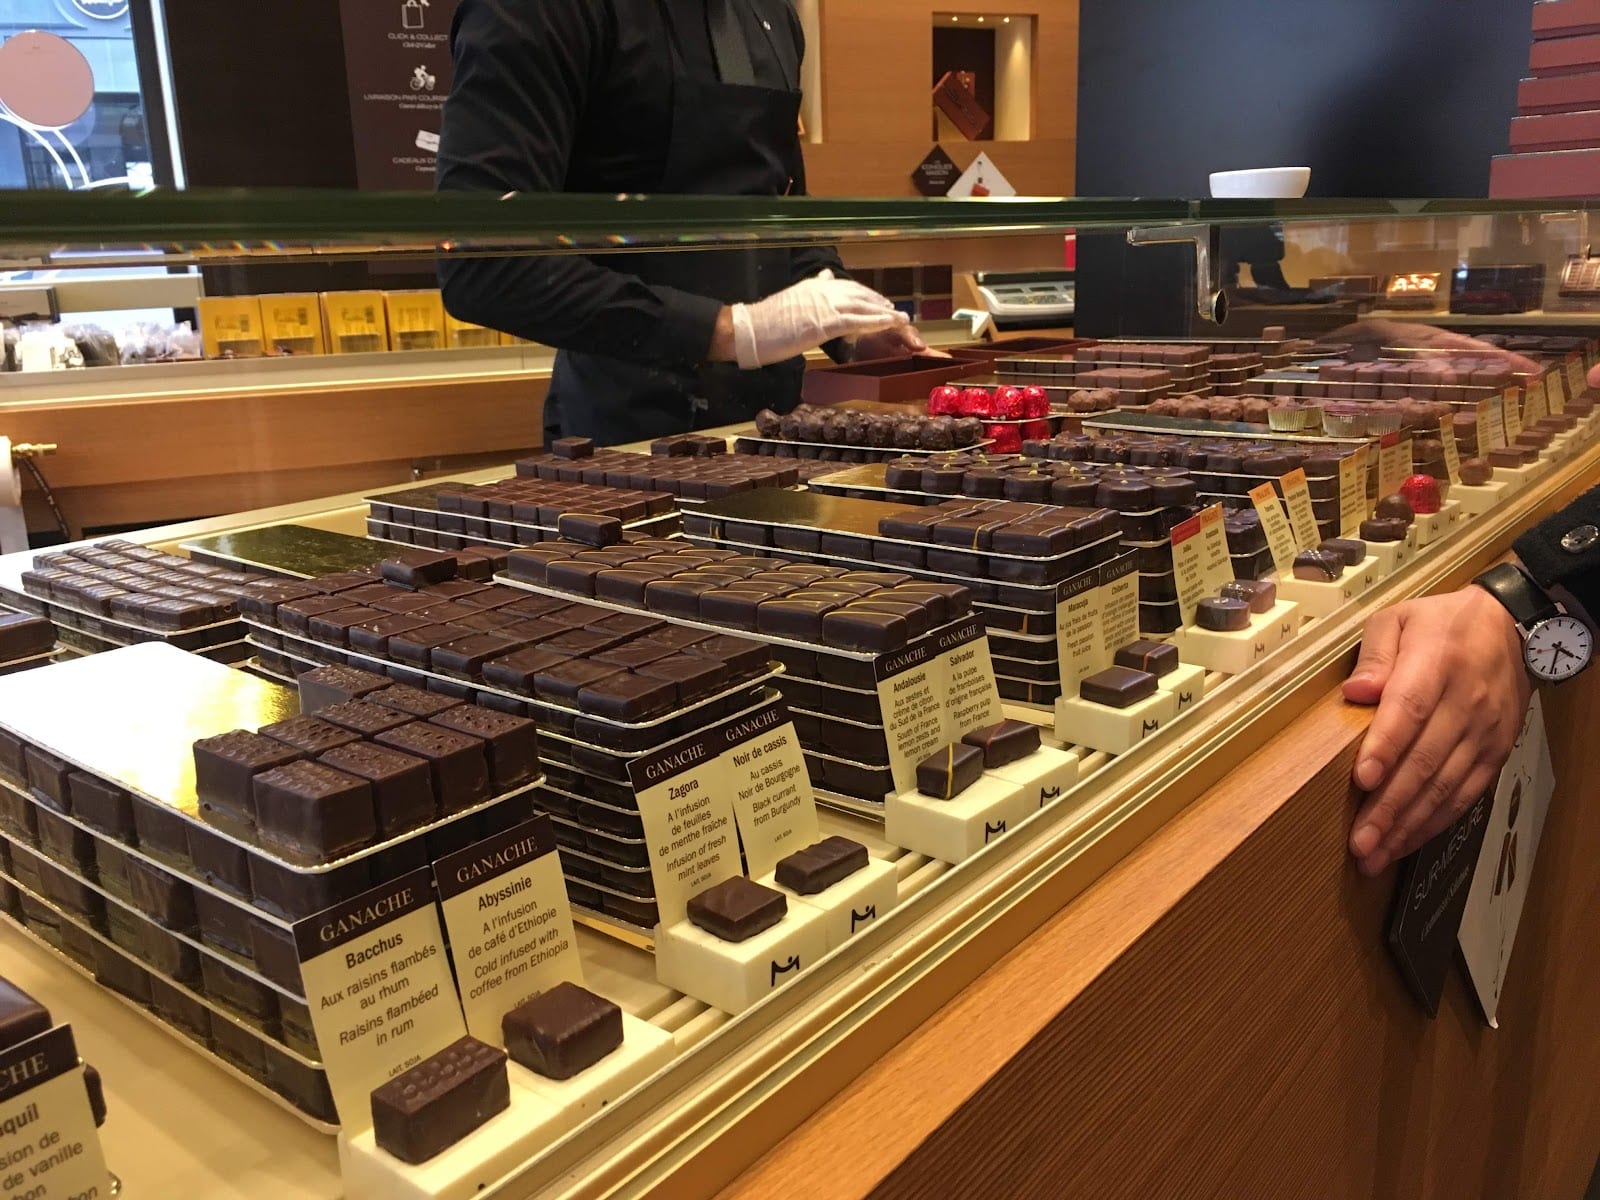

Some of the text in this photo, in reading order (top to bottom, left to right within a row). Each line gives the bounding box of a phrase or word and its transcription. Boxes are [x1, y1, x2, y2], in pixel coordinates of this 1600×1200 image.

[1063, 576, 1092, 596] GANACHE
[940, 623, 977, 648] GANACHE
[885, 646, 927, 672] GANACHE
[950, 649, 975, 667] Salvador
[893, 671, 926, 694] Andalousie
[949, 674, 985, 695] de framboises
[957, 671, 963, 680] la
[963, 666, 977, 679] pulpe
[895, 686, 930, 709] Aux zestes et
[911, 702, 918, 711] de
[919, 695, 934, 707] citron
[953, 697, 991, 720] Raspberry pulp
[726, 709, 779, 741] GANACHE
[890, 702, 940, 731] du Sud de la France
[897, 717, 938, 742] South of France
[960, 718, 971, 729] from
[972, 710, 990, 723] France
[733, 735, 787, 768] Noir de cassis
[898, 737, 915, 751] lemon
[930, 724, 941, 736] and
[904, 745, 921, 759] lemon
[921, 736, 939, 750] cream
[646, 743, 706, 779] GANACHE
[750, 759, 783, 781] Au cassis
[668, 779, 699, 801] Zagora
[738, 764, 800, 801] Noir de Bourgogne
[667, 796, 710, 823] A l'infusion
[753, 783, 797, 813] Black currant
[754, 795, 801, 827] from Burgundy
[659, 816, 728, 857] de menthe fraîche
[671, 810, 711, 836] de feuilles
[457, 836, 538, 883] GANACHE
[666, 835, 727, 873] Infusion of fresh
[678, 853, 720, 881] mint leaves
[478, 877, 532, 912] Abyssinie
[320, 887, 415, 942] GANACHE
[483, 901, 538, 935] A l'infusion
[468, 908, 557, 960] de café d'Ethiopie
[345, 933, 403, 970] Bacchus
[474, 928, 559, 979] Cold infused with
[321, 944, 437, 1010] Aux raisins flambés
[469, 940, 569, 1000] coffee from Ethiopia
[359, 977, 410, 1010] au rhum
[339, 983, 439, 1047] Raisins flambéed
[376, 1018, 414, 1047] in rum
[0, 1052, 49, 1091] CHE
[404, 1054, 422, 1069] SOJA
[0, 1130, 61, 1171] sion de
[2, 1141, 84, 1191] de vanille
